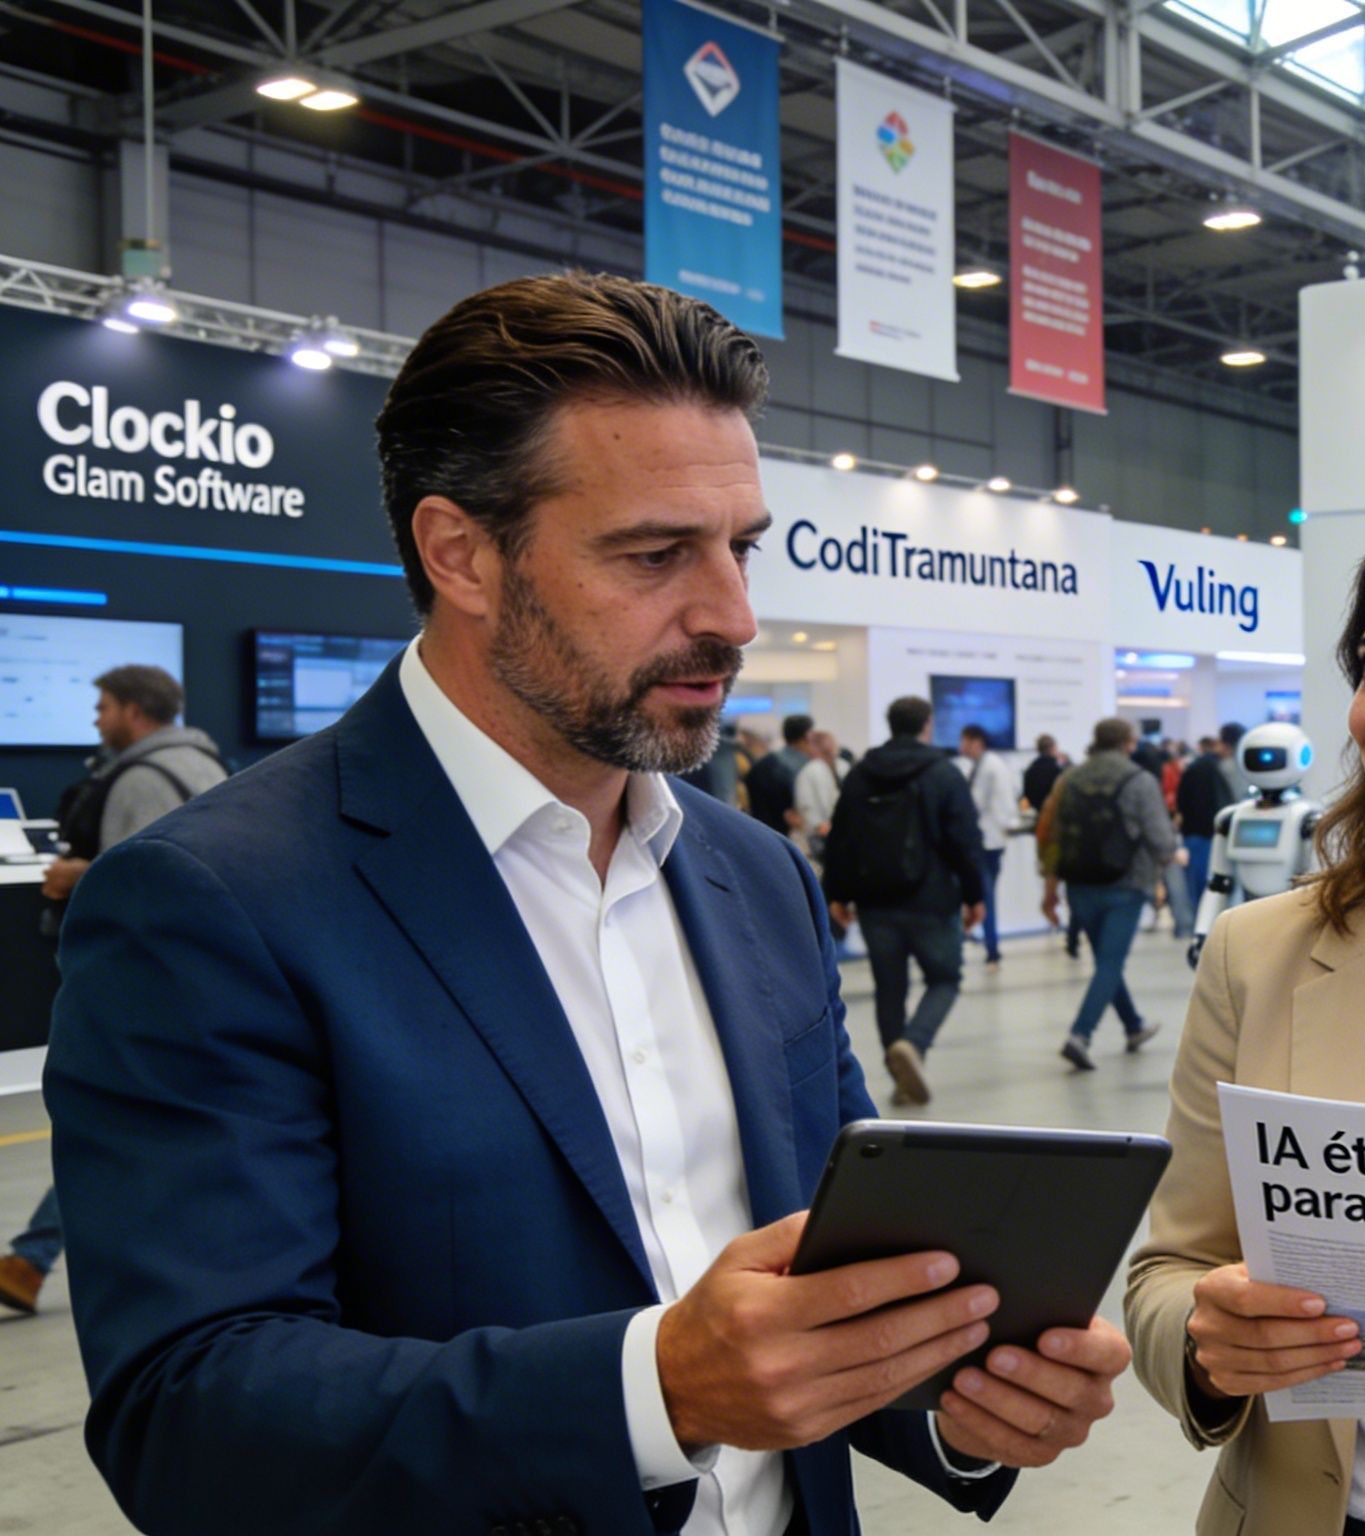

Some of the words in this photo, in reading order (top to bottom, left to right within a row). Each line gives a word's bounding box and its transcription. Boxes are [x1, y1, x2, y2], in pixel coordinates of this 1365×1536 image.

[37, 381, 274, 468] Clockio
[43, 455, 144, 502] Glam
[154, 466, 305, 518] Software
[787, 520, 1078, 595] CodiTramuntana
[1138, 559, 1259, 632] Vuling
[1256, 1121, 1309, 1170] IA
